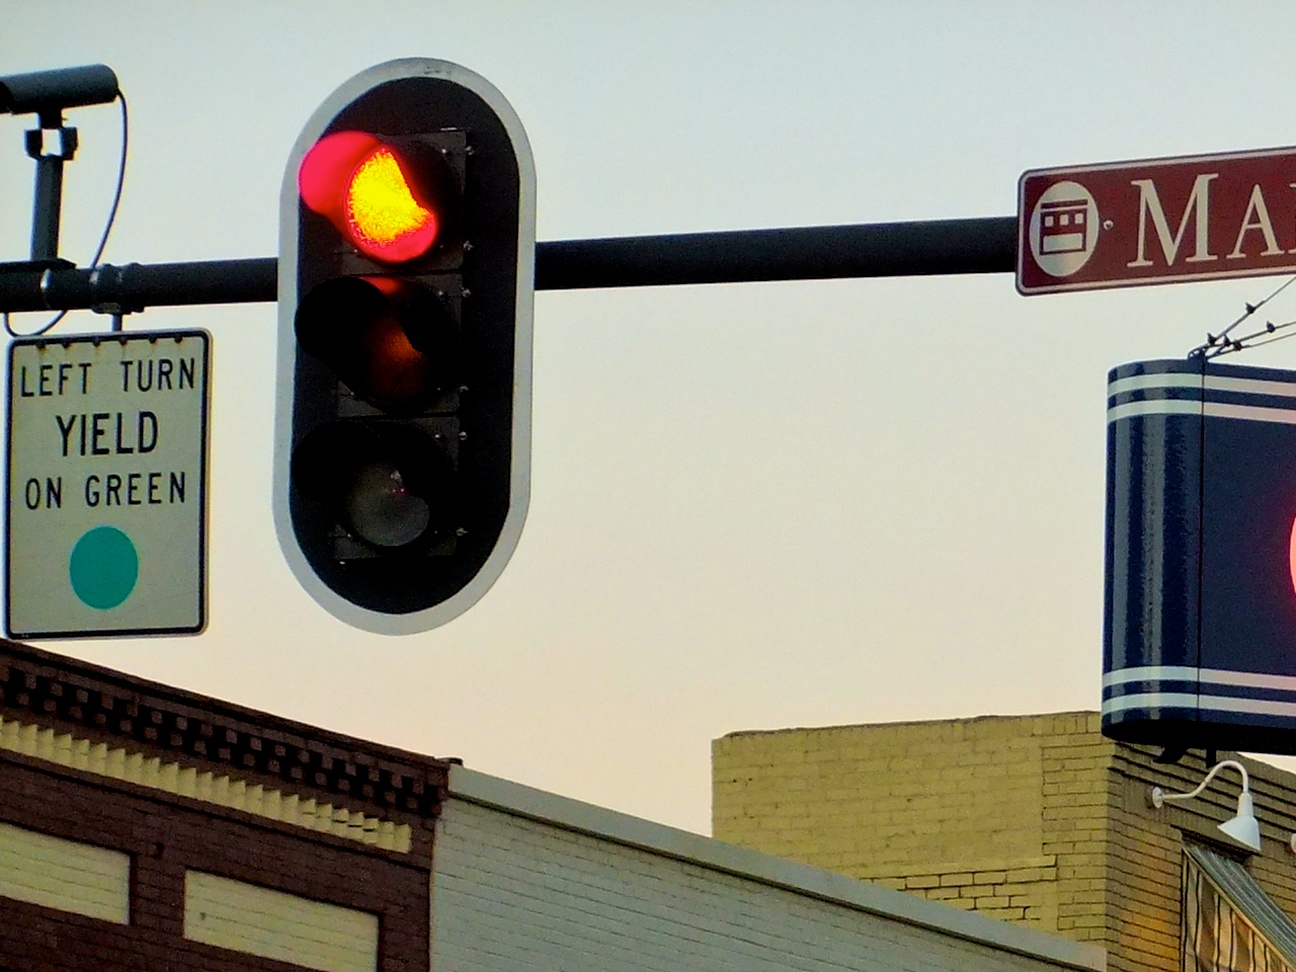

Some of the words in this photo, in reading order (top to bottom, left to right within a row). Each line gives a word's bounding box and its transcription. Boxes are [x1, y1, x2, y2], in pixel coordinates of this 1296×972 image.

[21, 363, 92, 397] LEFT
[121, 358, 195, 392] TURN
[55, 410, 159, 457] YIELD
[25, 476, 62, 510] ON
[85, 471, 186, 508] GREEN
